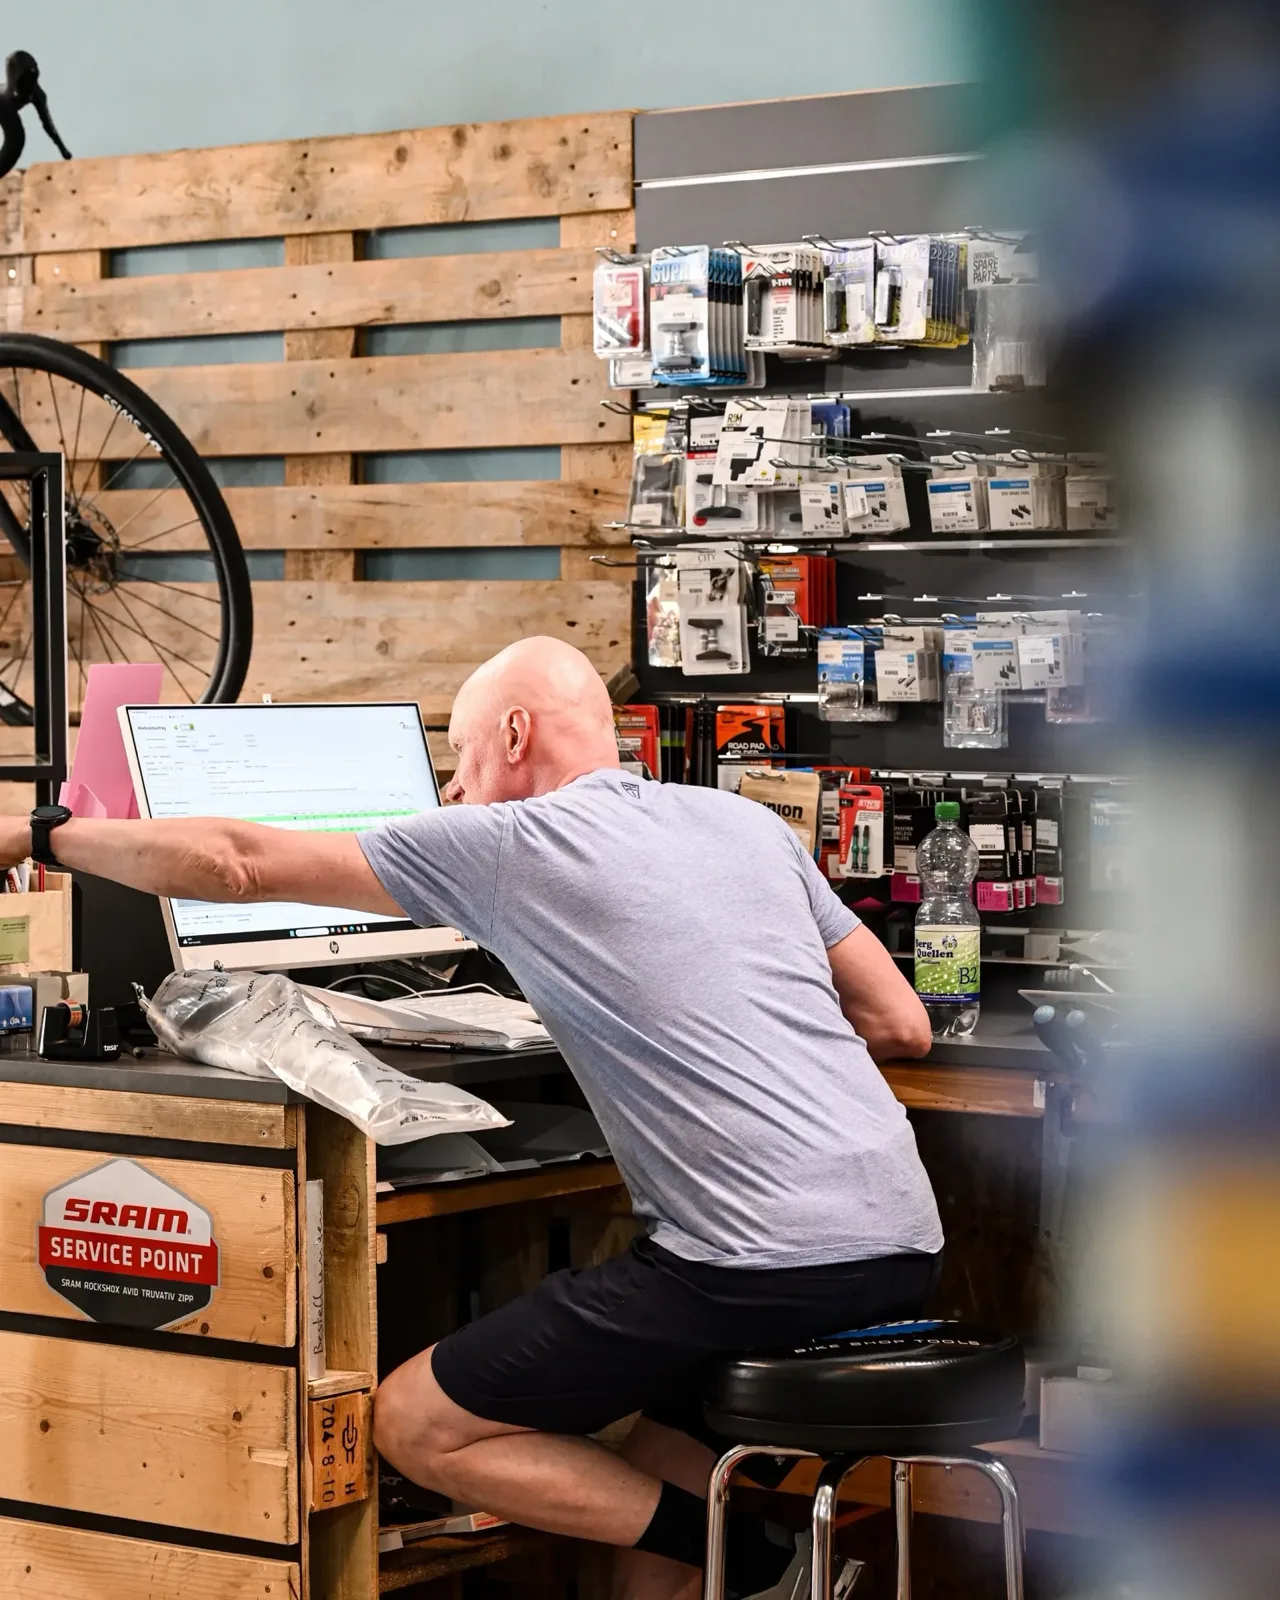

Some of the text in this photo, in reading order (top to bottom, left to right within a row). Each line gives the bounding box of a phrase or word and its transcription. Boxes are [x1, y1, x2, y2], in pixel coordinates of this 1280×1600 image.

[973, 258, 998, 272] SPARE
[973, 270, 997, 284] PARTS
[103, 393, 142, 429] SWISS
[697, 554, 716, 563] CITY
[728, 742, 765, 750] ROAD PAD
[916, 948, 954, 958] Quellen
[959, 966, 977, 985] B2
[103, 1044, 117, 1052] tesa
[63, 1198, 189, 1235] SRAM
[50, 1236, 203, 1275] SERVICE POINT
[61, 1278, 194, 1303] SRAM ROCKSHOX AVID TRUVATIV ZIPP
[794, 1343, 840, 1354] BIKE
[849, 1339, 905, 1347] SHOP
